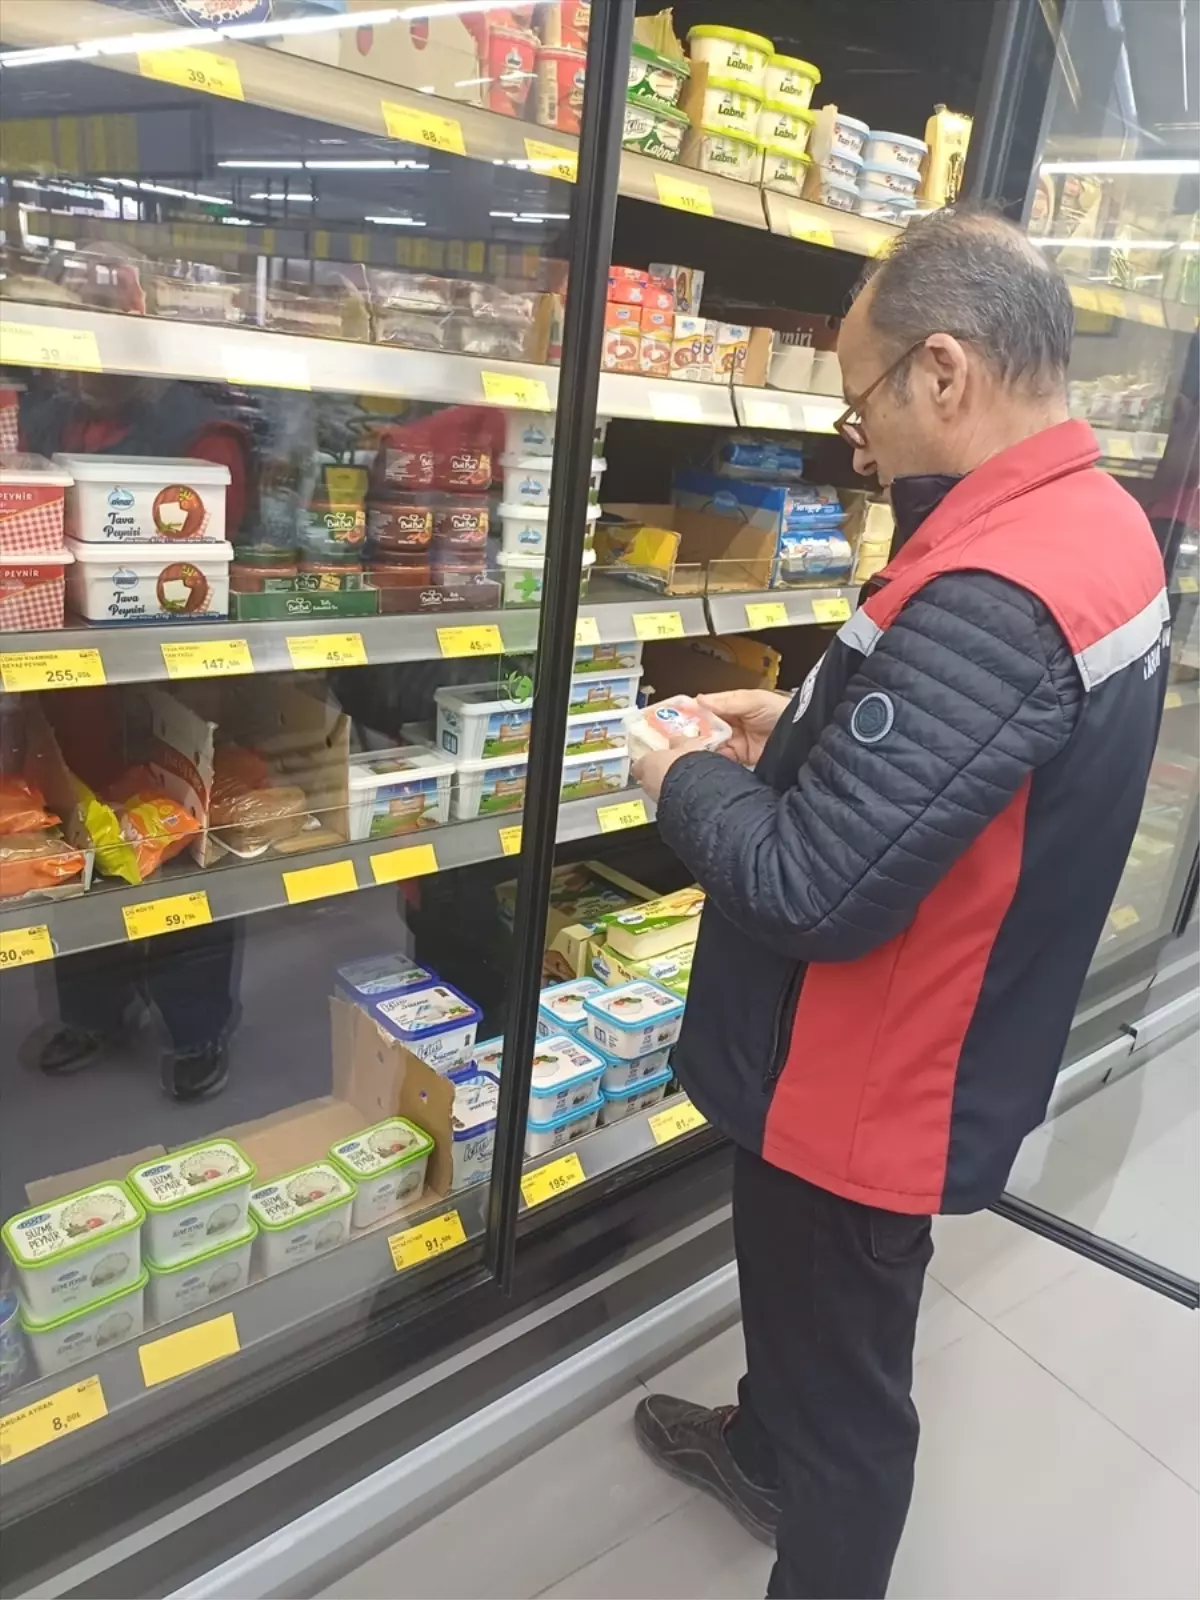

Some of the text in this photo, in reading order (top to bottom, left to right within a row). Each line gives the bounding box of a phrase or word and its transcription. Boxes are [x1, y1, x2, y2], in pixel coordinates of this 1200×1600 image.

[727, 56, 753, 72] Labne
[780, 82, 803, 96] Labne
[718, 103, 745, 119] Labne
[774, 126, 797, 140] Labne
[643, 139, 676, 161] Labne
[709, 150, 738, 165] Labne
[774, 170, 797, 182] Labne
[107, 512, 135, 525] Tava
[4, 568, 39, 578] PEYNİR
[113, 591, 139, 604] Tava
[153, 1178, 183, 1195] PEYNİR
[25, 1222, 53, 1240] SÜZME
[28, 1231, 60, 1250] PEYNİR
